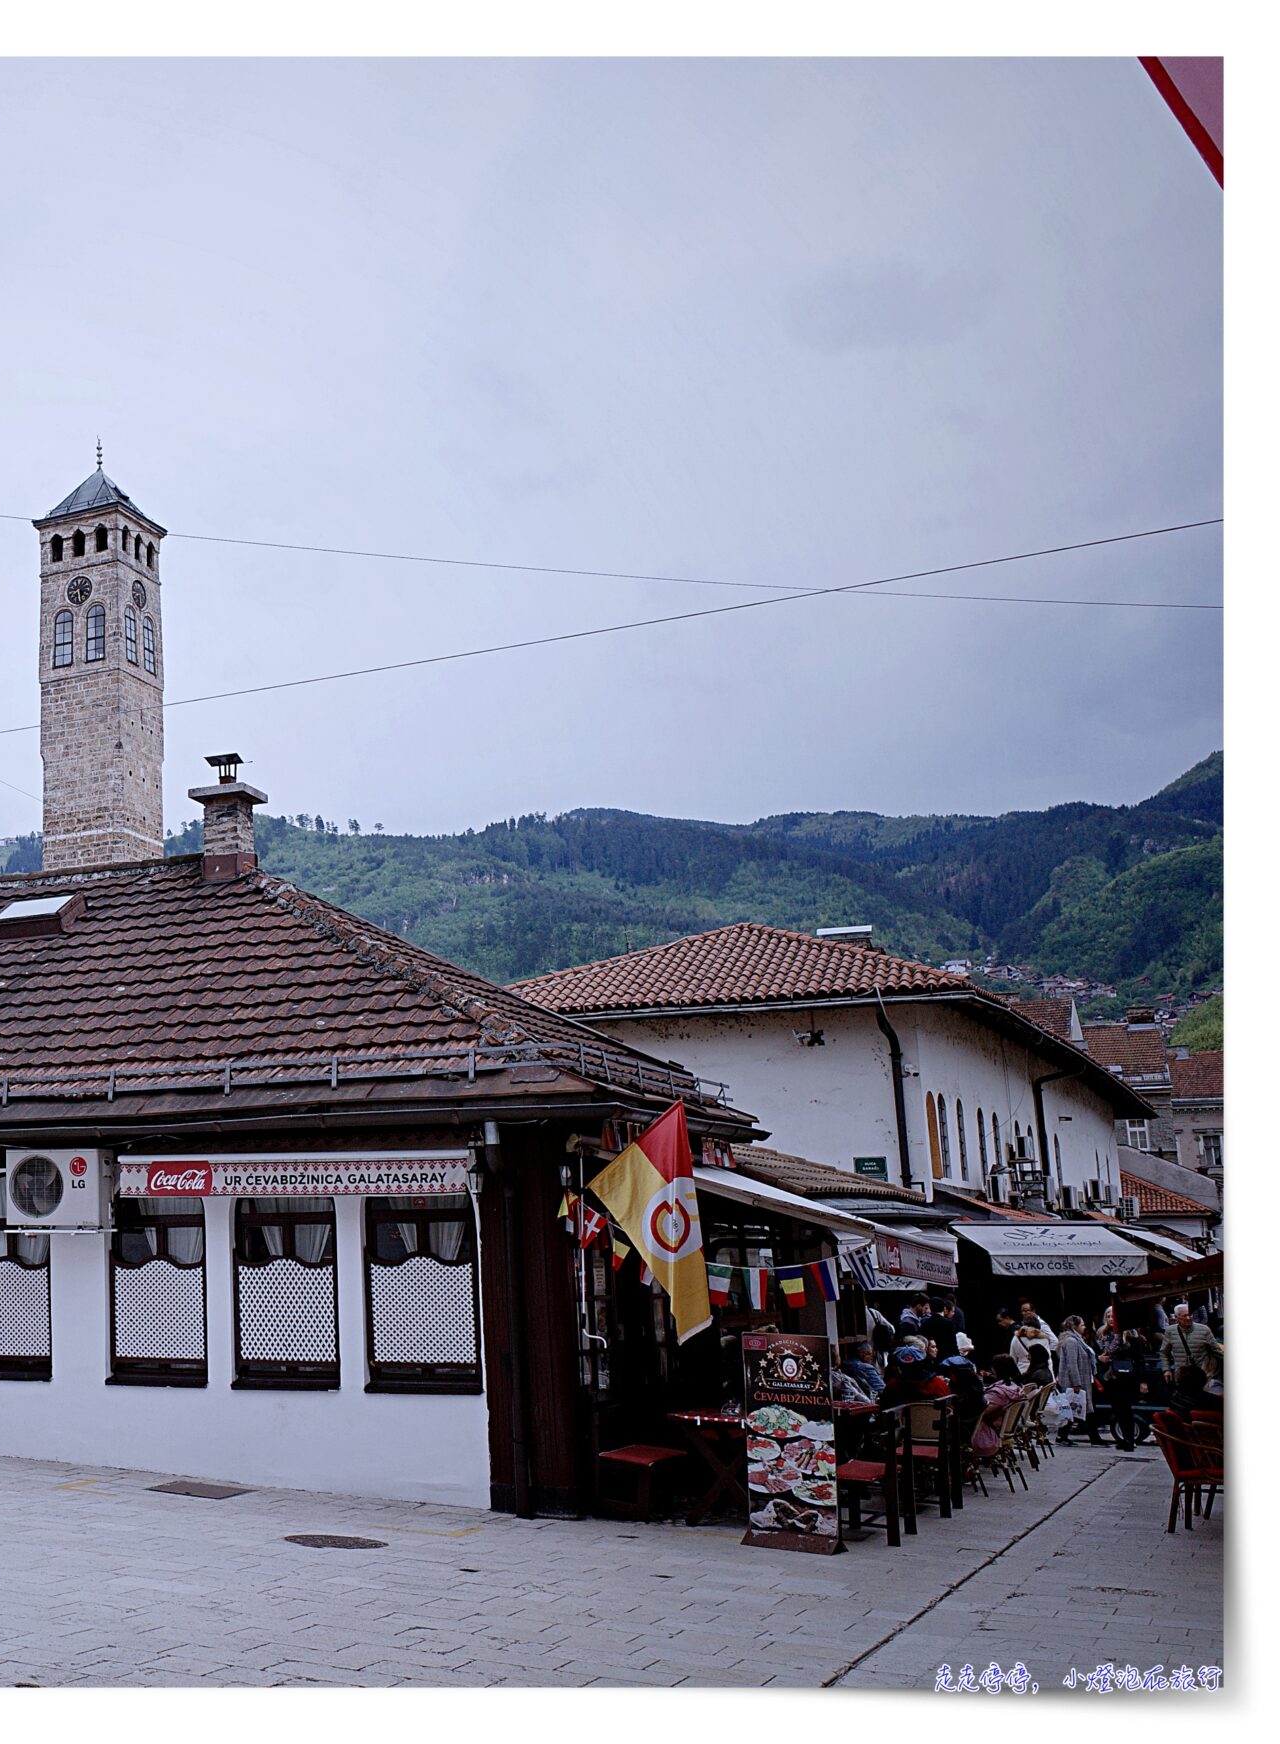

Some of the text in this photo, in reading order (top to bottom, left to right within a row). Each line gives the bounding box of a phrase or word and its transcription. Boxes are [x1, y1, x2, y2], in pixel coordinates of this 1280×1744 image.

[71, 1179, 86, 1189] LG
[150, 1168, 210, 1190] Coca-Cola
[224, 1172, 447, 1186] UR ĆEVABDŽINICA GALATASARAY
[1005, 1261, 1045, 1271] SLATKO
[772, 1381, 811, 1389] GALATASARAY
